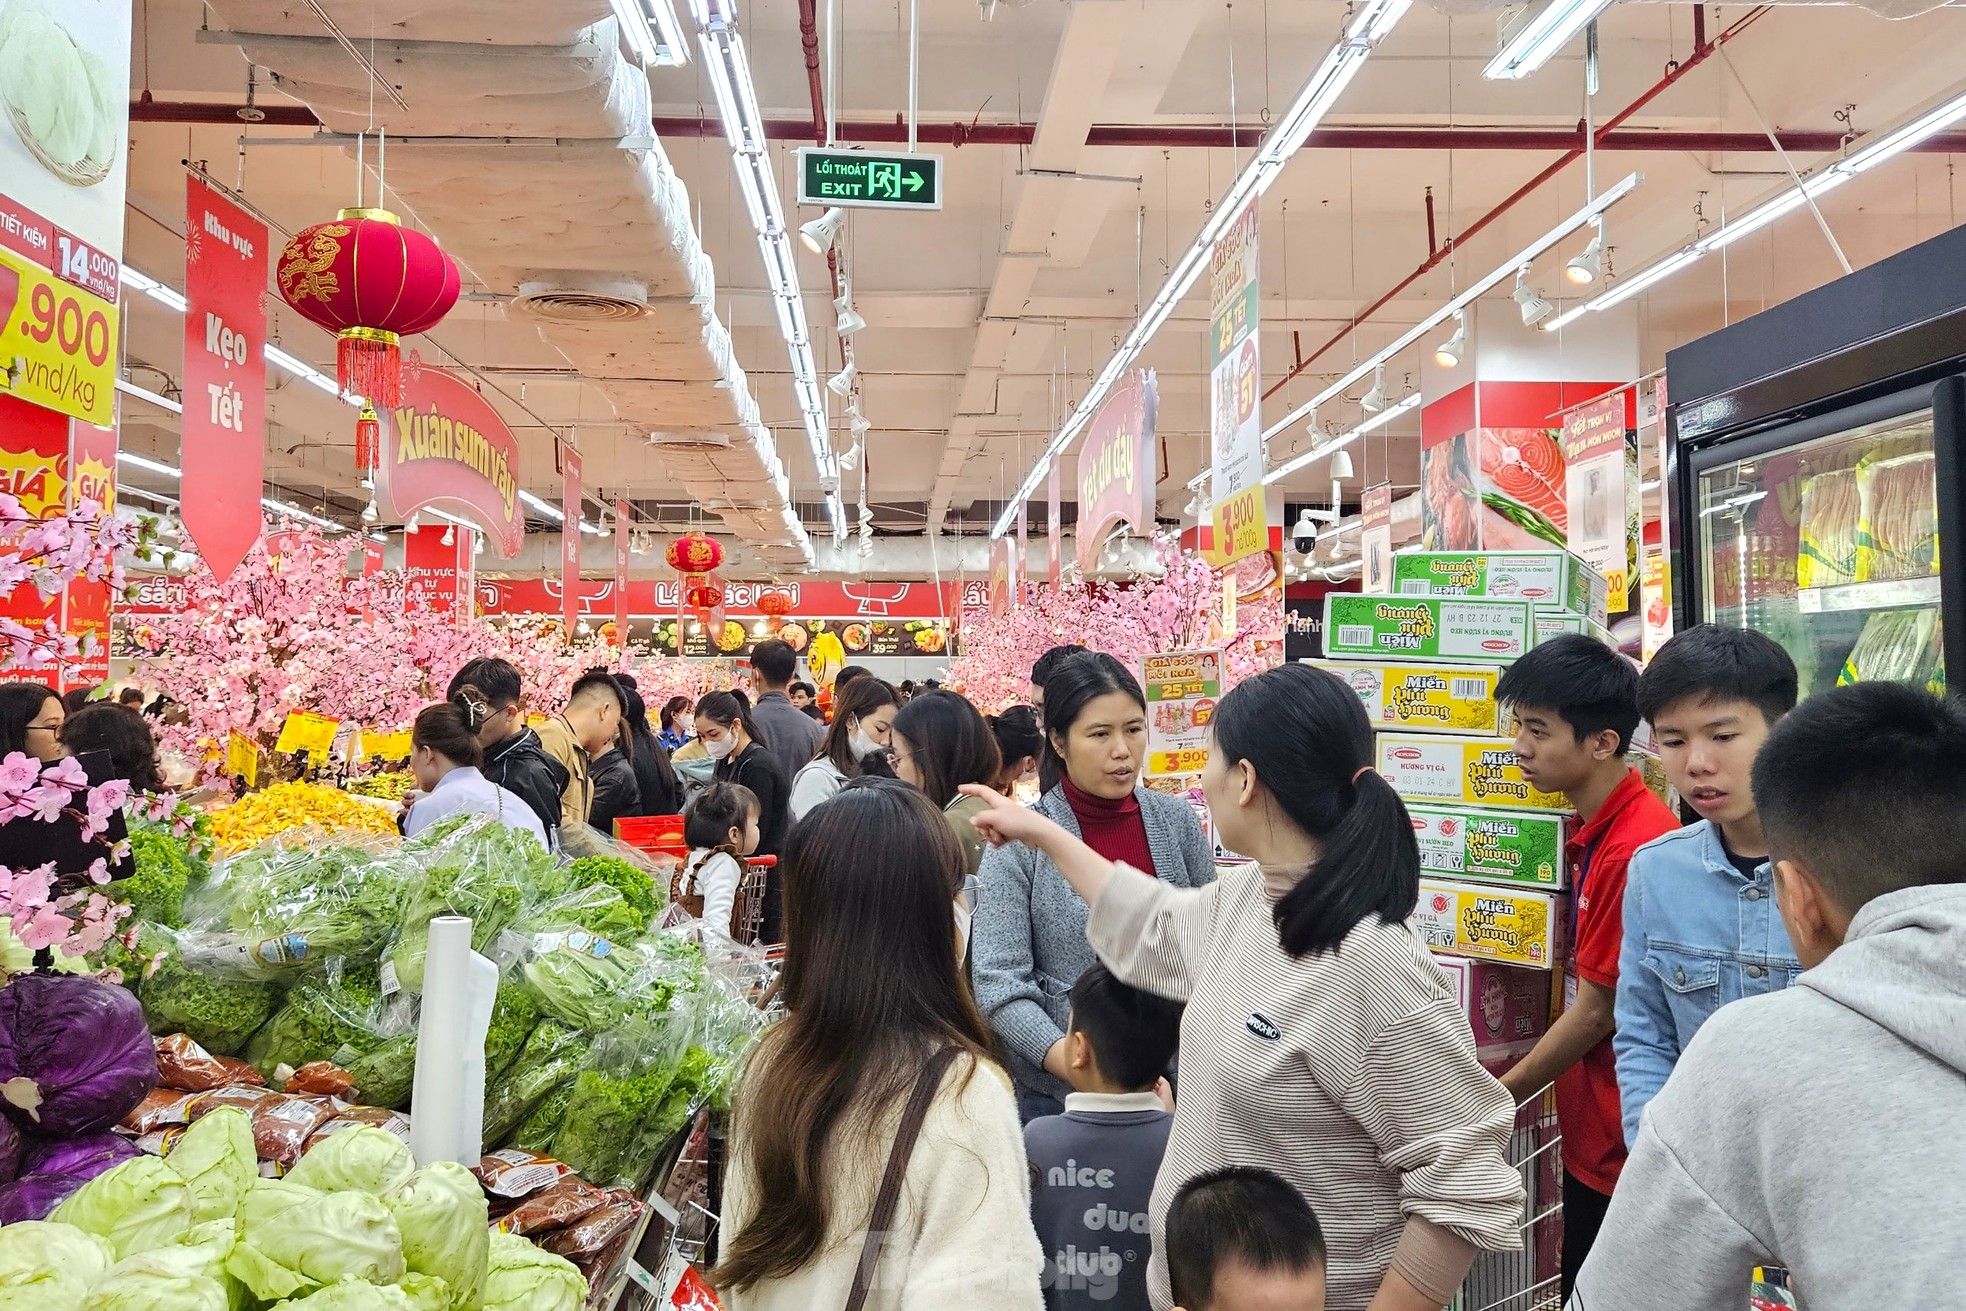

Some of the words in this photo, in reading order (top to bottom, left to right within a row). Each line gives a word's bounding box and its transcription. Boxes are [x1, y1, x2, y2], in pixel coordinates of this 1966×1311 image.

[816, 159, 832, 174] LỐI
[834, 162, 867, 176] THOÁT
[821, 182, 862, 196] EXIT
[0, 212, 22, 236] TIẾT
[23, 227, 47, 250] KIỆM
[204, 210, 230, 245] Khu
[232, 232, 254, 260] vực
[90, 275, 116, 304] vnd/kg
[206, 311, 247, 369] Kẹo
[25, 357, 96, 412] vnd/kg
[208, 381, 244, 433] Tết
[1571, 413, 1586, 438] Tết
[1587, 414, 1605, 430] TRỌN
[395, 402, 454, 465] Xuân
[454, 420, 489, 479] sum
[1586, 436, 1601, 450] MÓN
[1600, 428, 1622, 447] NGON
[1083, 454, 1098, 521] Tết
[1222, 492, 1254, 556] 3.900
[433, 567, 454, 579] vực
[424, 578, 437, 591] tự
[439, 591, 453, 601] vụ
[1467, 612, 1477, 622] 23
[1480, 613, 1490, 623] 12
[1379, 634, 1422, 650] Miến
[1161, 683, 1183, 699] 25
[1185, 681, 1204, 692] TẾT
[1406, 675, 1447, 690] Miến
[1393, 686, 1427, 705] Phú
[1401, 763, 1424, 771] HƯƠNG
[1426, 764, 1435, 773] VỊ
[1435, 763, 1446, 772] GÀ
[1469, 763, 1503, 782] Phú
[1479, 820, 1518, 835] Miến
[1468, 831, 1498, 846] Phú
[1477, 898, 1515, 915] Miến
[1419, 914, 1427, 923] VỊ
[1427, 914, 1438, 923] GÀ
[1464, 908, 1496, 926] Phú
[1048, 1158, 1115, 1189] nice
[1083, 1203, 1151, 1234] dua
